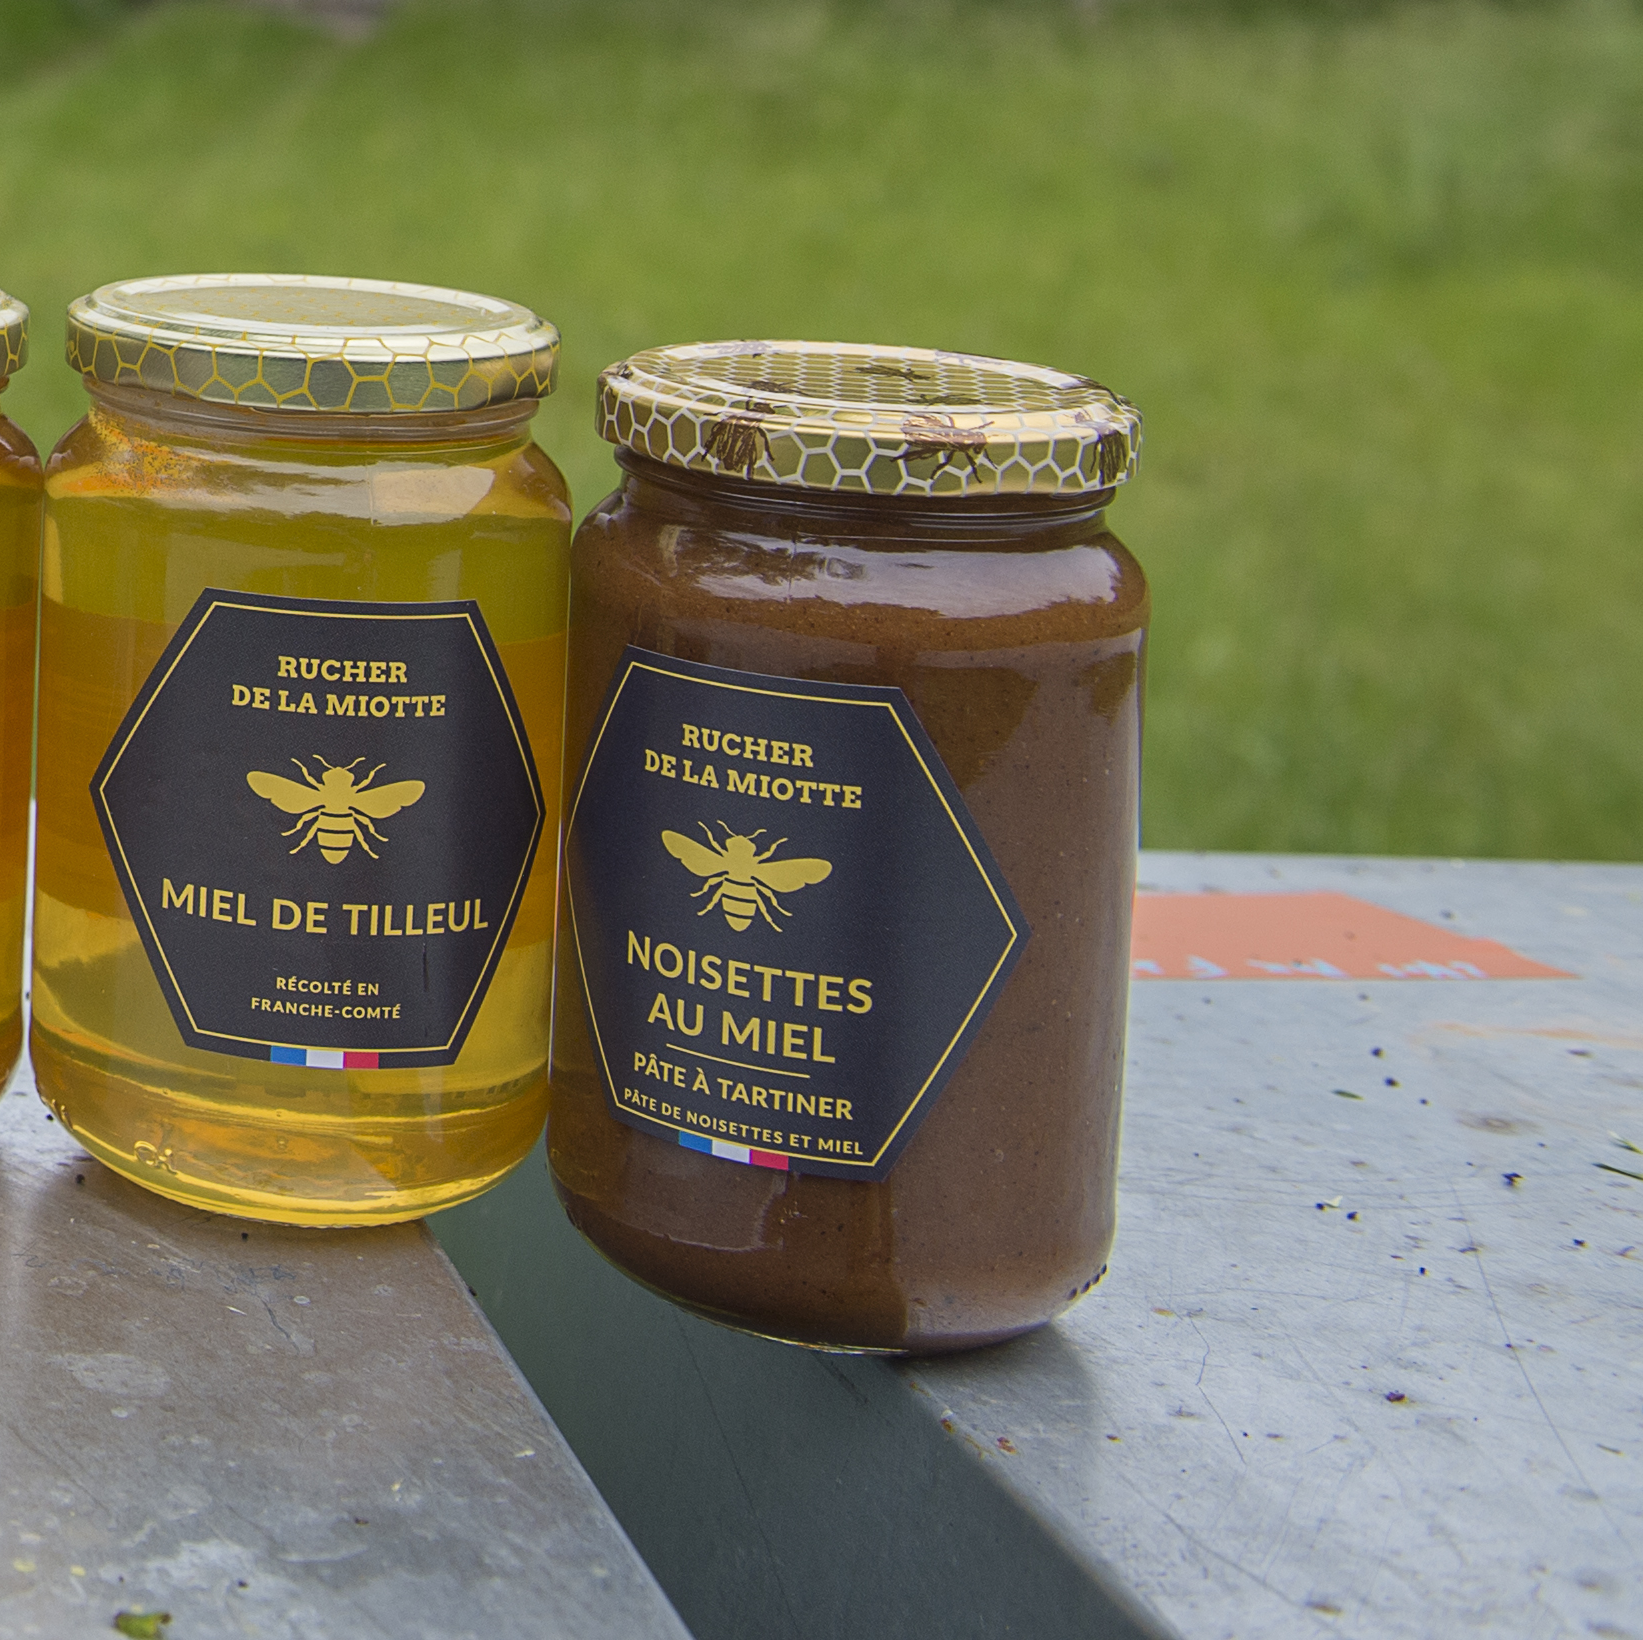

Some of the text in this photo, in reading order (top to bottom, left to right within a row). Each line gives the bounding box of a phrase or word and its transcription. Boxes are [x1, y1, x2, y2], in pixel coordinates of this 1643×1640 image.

[277, 655, 407, 683] RUCHER
[231, 684, 446, 718] DE LA MIOTTE
[681, 723, 813, 768] RUCHER
[644, 748, 862, 809] DE LA MIOTTE
[161, 877, 488, 936] MIEL DE TILLEUL
[275, 975, 379, 996] RÉCOLTÉ EN
[627, 930, 872, 1015] NOISETTES
[250, 996, 400, 1019] FRANCHE-COMTÉ
[647, 992, 836, 1064] AU MIEL
[633, 1051, 852, 1120] PÂTE À TARTINER
[623, 1087, 863, 1155] PÂTE DE NOISETTES ET MIEL
